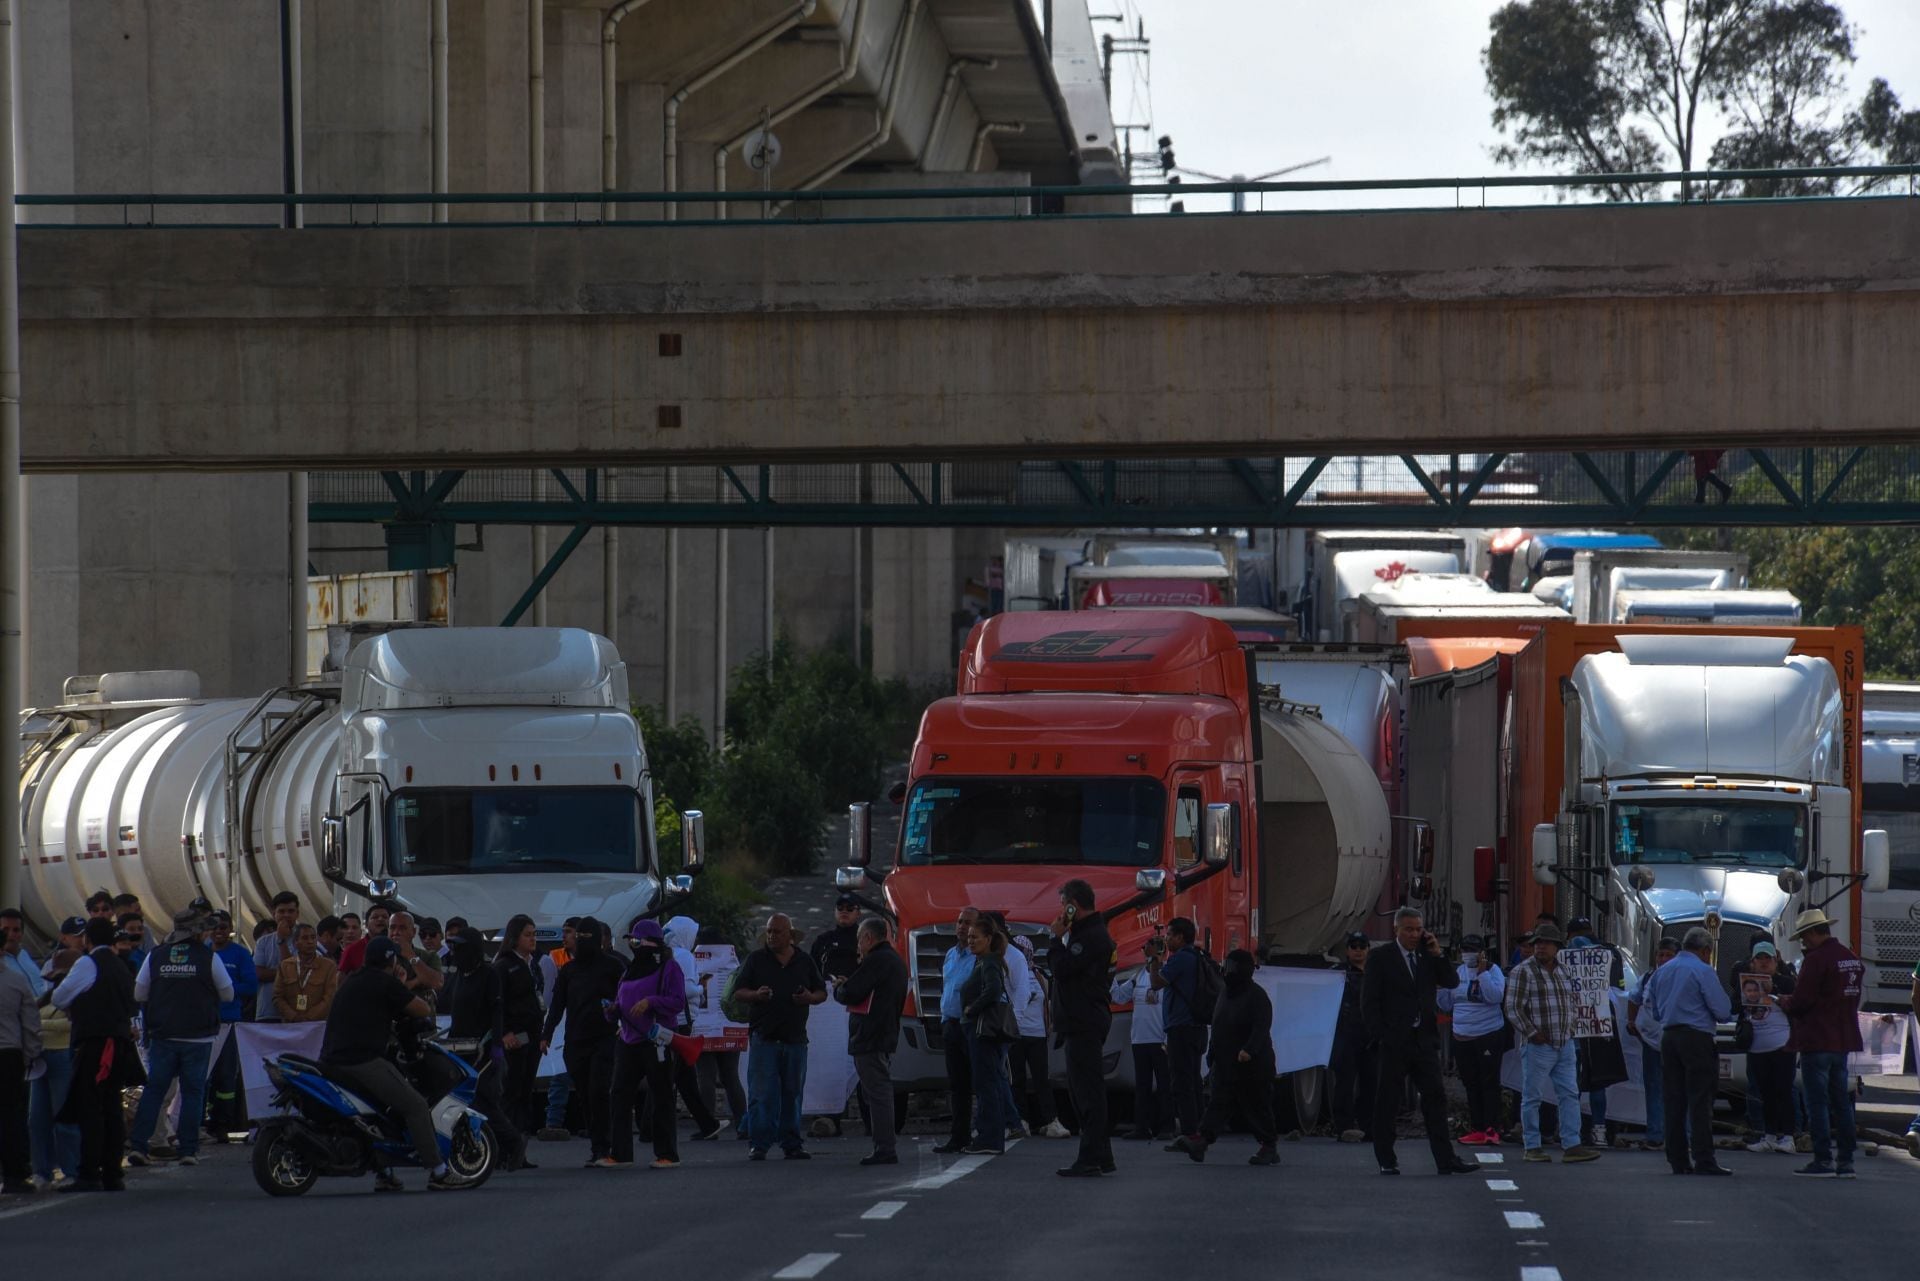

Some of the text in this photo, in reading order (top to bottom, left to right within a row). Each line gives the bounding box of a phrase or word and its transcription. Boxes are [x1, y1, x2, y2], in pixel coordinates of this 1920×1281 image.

[1843, 650, 1855, 712] SNLU
[160, 964, 197, 973] CODHEM
[1580, 965, 1606, 978] UNAS
